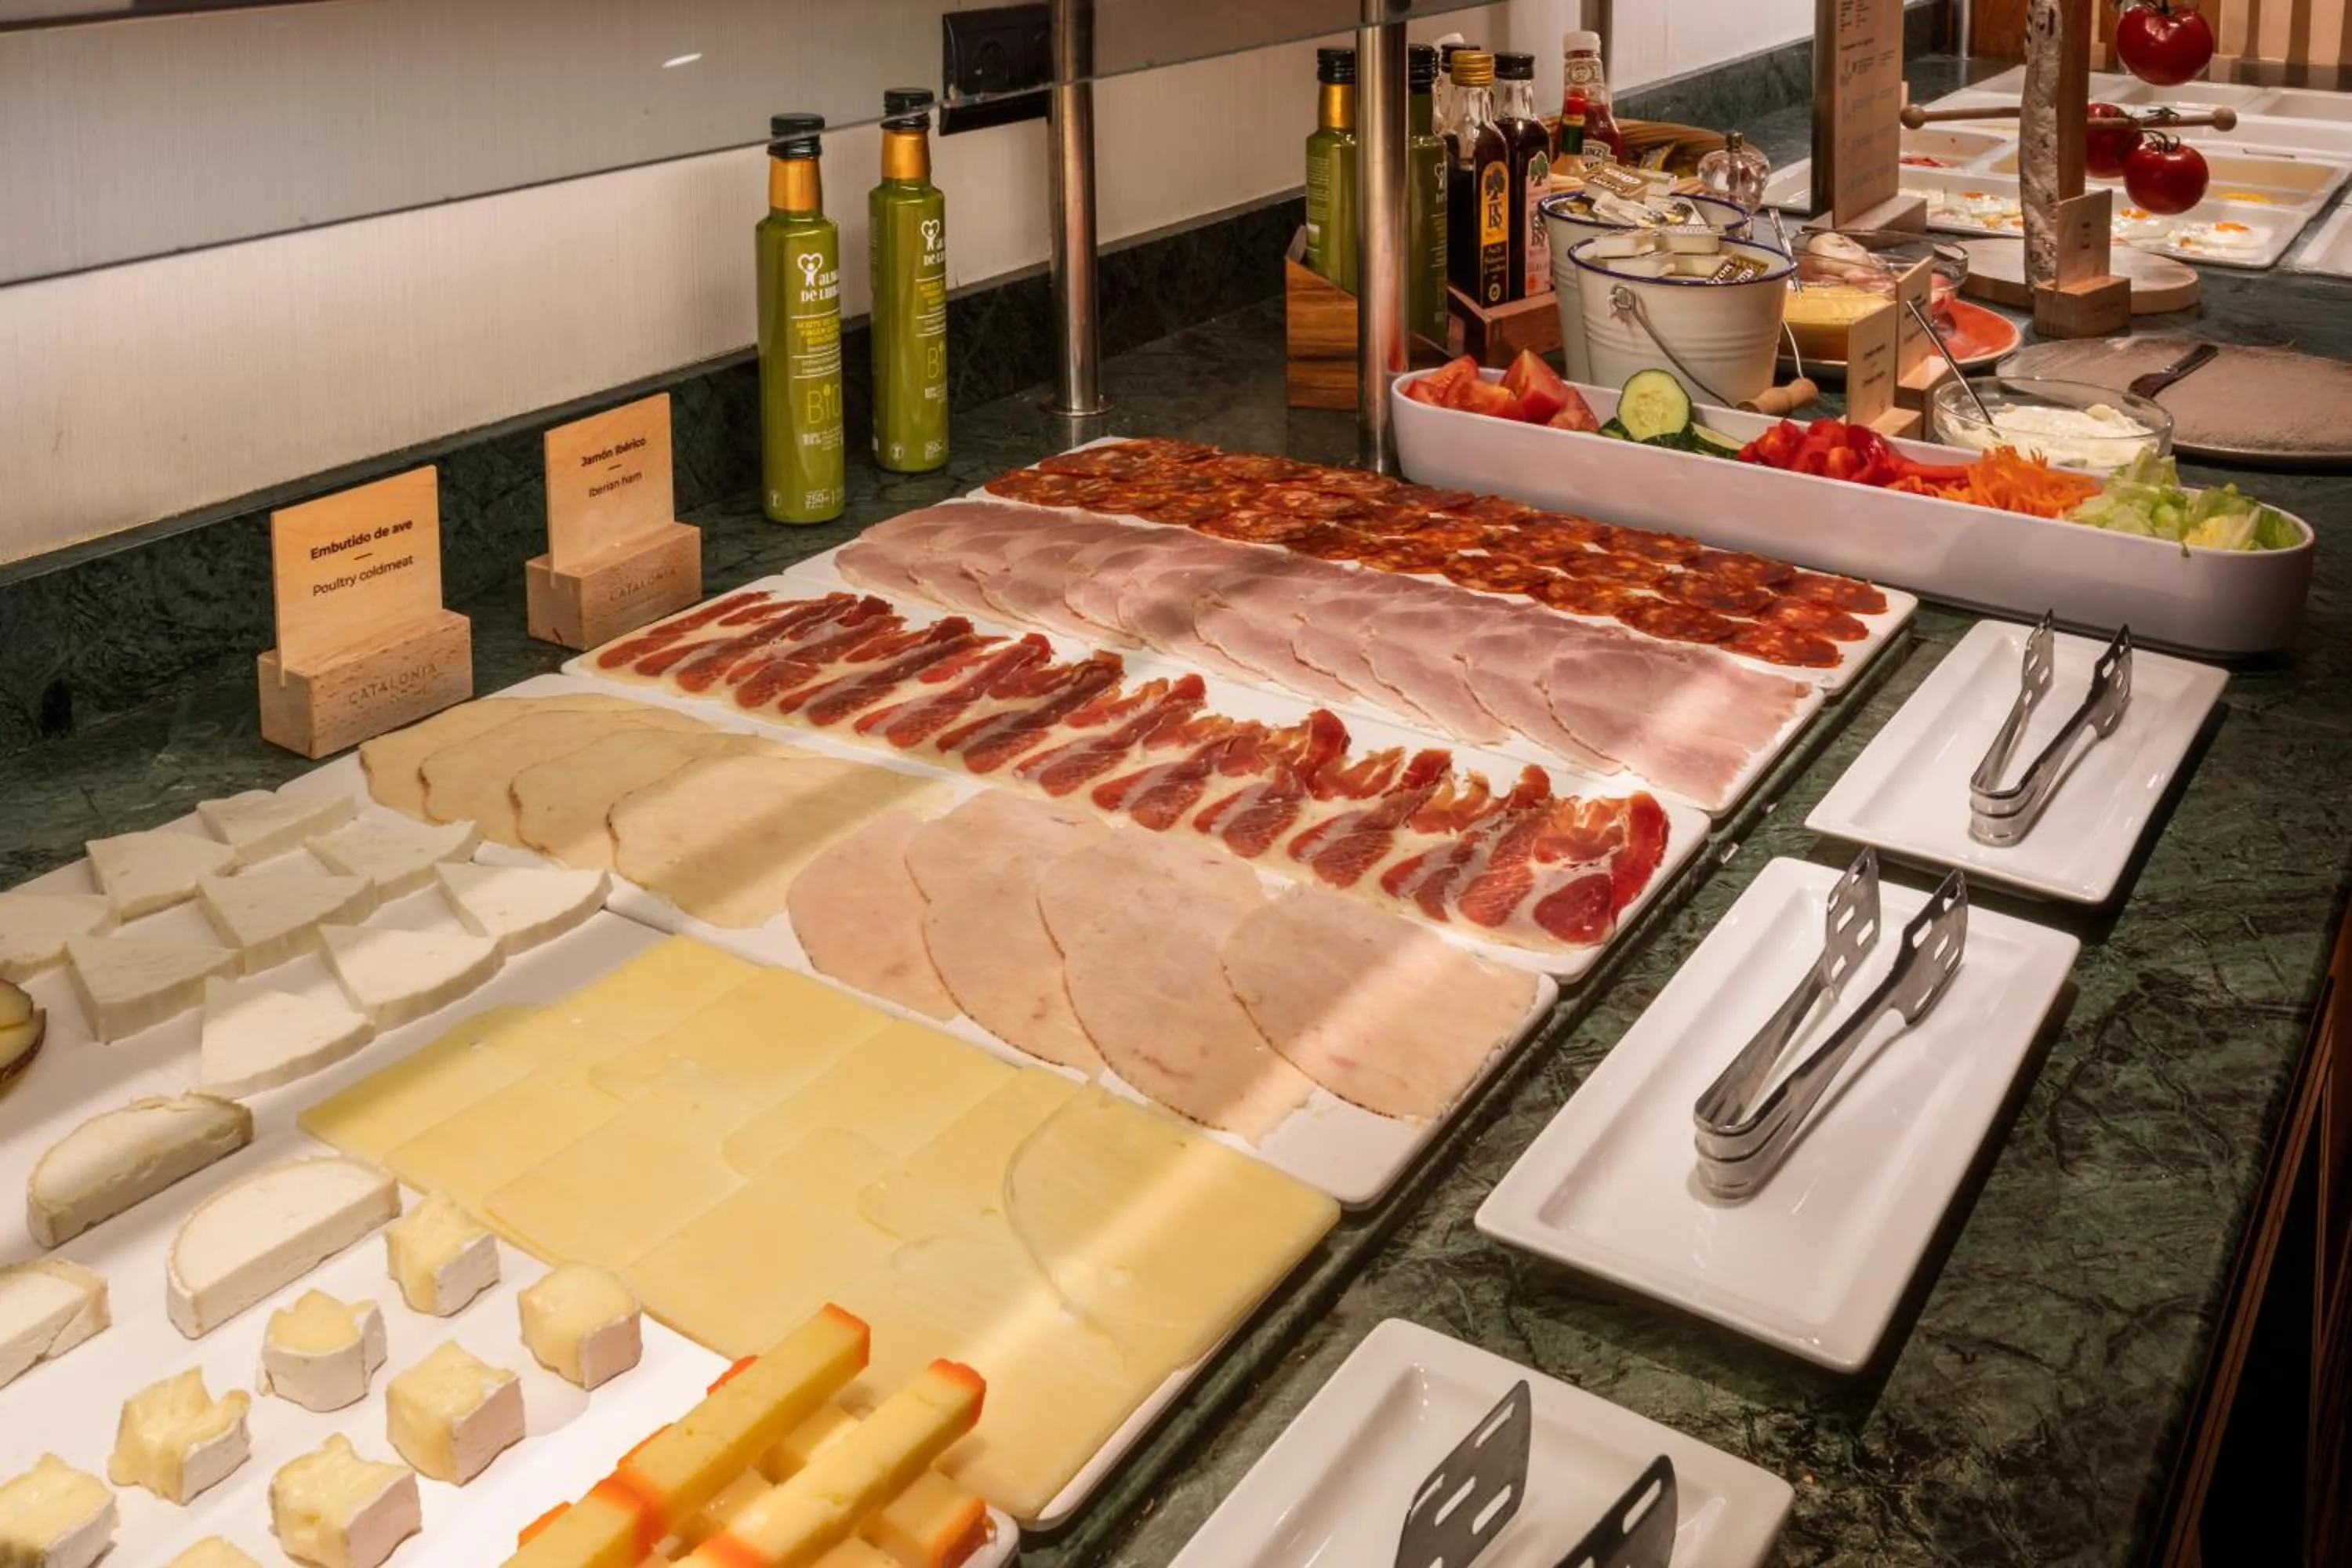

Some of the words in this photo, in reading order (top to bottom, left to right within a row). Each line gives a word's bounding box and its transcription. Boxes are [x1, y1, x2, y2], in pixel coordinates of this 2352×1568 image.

[580, 447, 613, 467] Jamón
[615, 437, 647, 456] Ibérico
[588, 479, 620, 498] Iberian
[621, 470, 642, 485] ham
[310, 532, 372, 560] Embutido
[373, 526, 390, 539] de
[392, 520, 413, 534] ave
[313, 573, 358, 596] Poultry
[359, 554, 414, 581] coldmeat
[348, 663, 438, 705] CATALONIA
